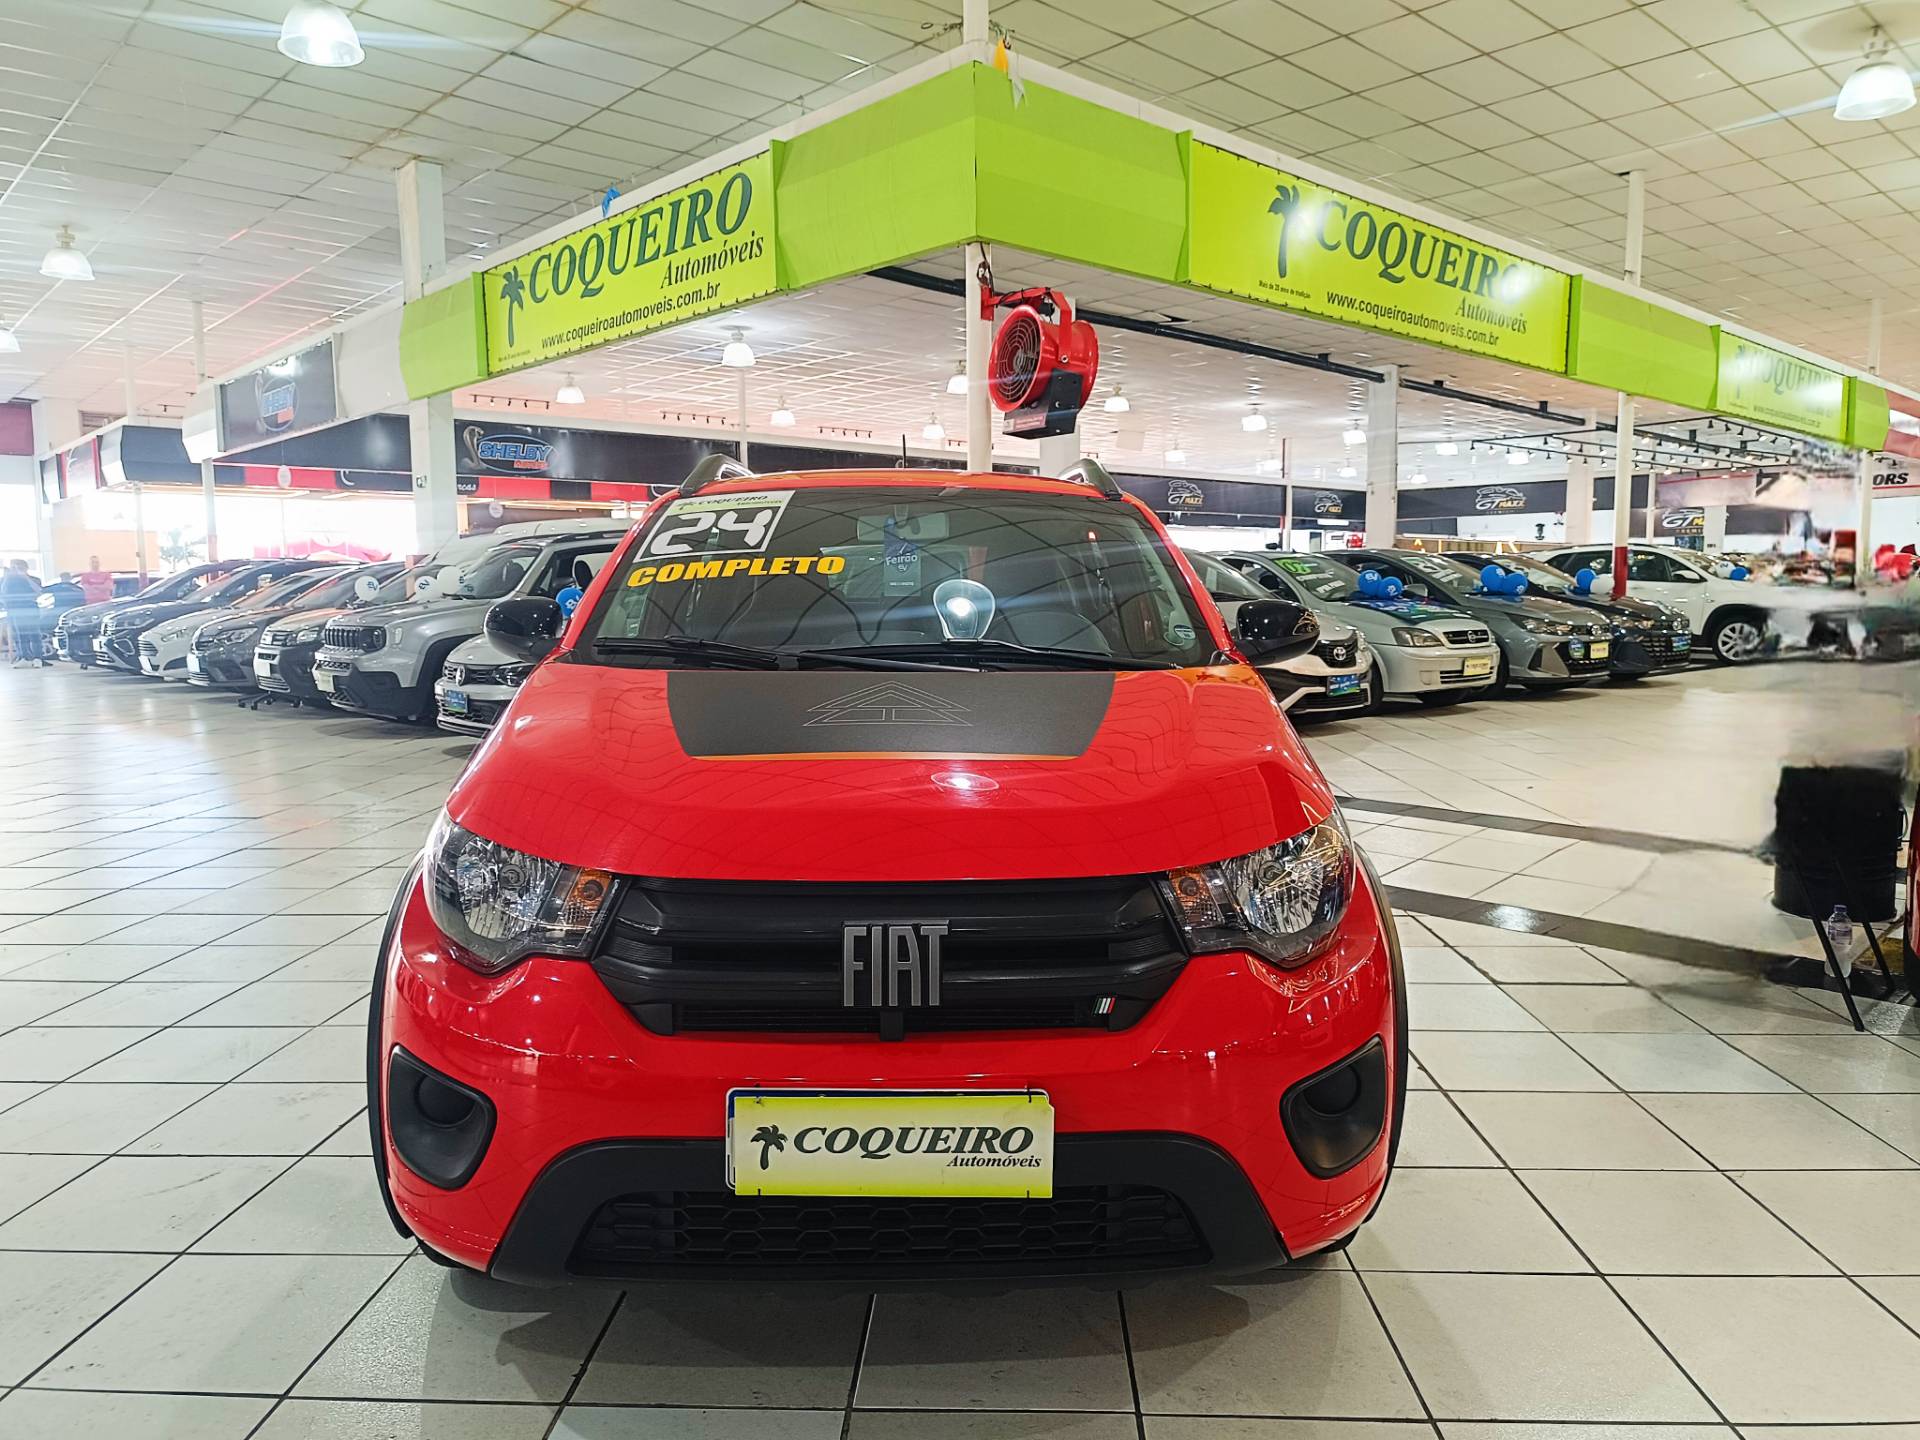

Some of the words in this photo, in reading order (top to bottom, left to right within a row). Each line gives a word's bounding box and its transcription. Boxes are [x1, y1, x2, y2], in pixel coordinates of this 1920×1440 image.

[529, 172, 753, 304] COQUEIRO
[660, 230, 764, 289] Automóveis
[541, 281, 721, 349] www.coqueiroautomoveis.com.br
[1326, 290, 1500, 347] www.coqueiroautomoveis.com.br
[479, 441, 553, 461] SHELBY
[650, 509, 774, 556] 24
[1662, 514, 1694, 528] GT
[626, 556, 847, 588] COMPLETO
[885, 552, 918, 566] Feirão
[843, 923, 949, 1007] FIAT
[793, 1126, 1034, 1160] COQUEIRO
[946, 1155, 1042, 1169] Automóveis
